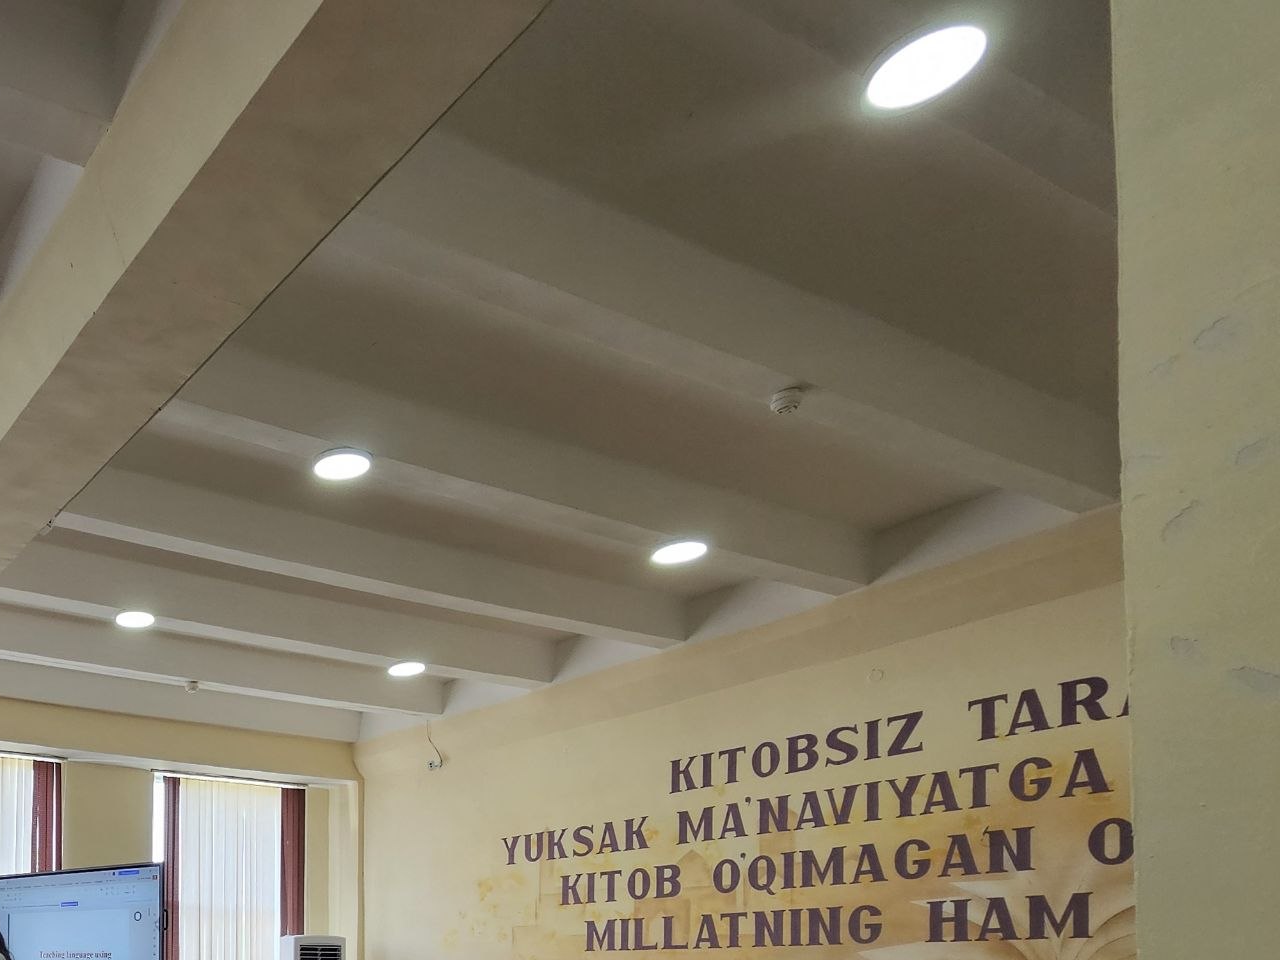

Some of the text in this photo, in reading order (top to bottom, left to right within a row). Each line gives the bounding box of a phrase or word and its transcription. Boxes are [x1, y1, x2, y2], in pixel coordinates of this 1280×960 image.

[669, 710, 924, 794] KITOBSIZ
[501, 748, 1115, 866] YUKSAK MA'NAVIYATGA
[560, 864, 681, 906] KITOB
[584, 891, 1094, 952] MILLATNING HAM
[66, 951, 94, 960] language
[94, 951, 112, 960] using
